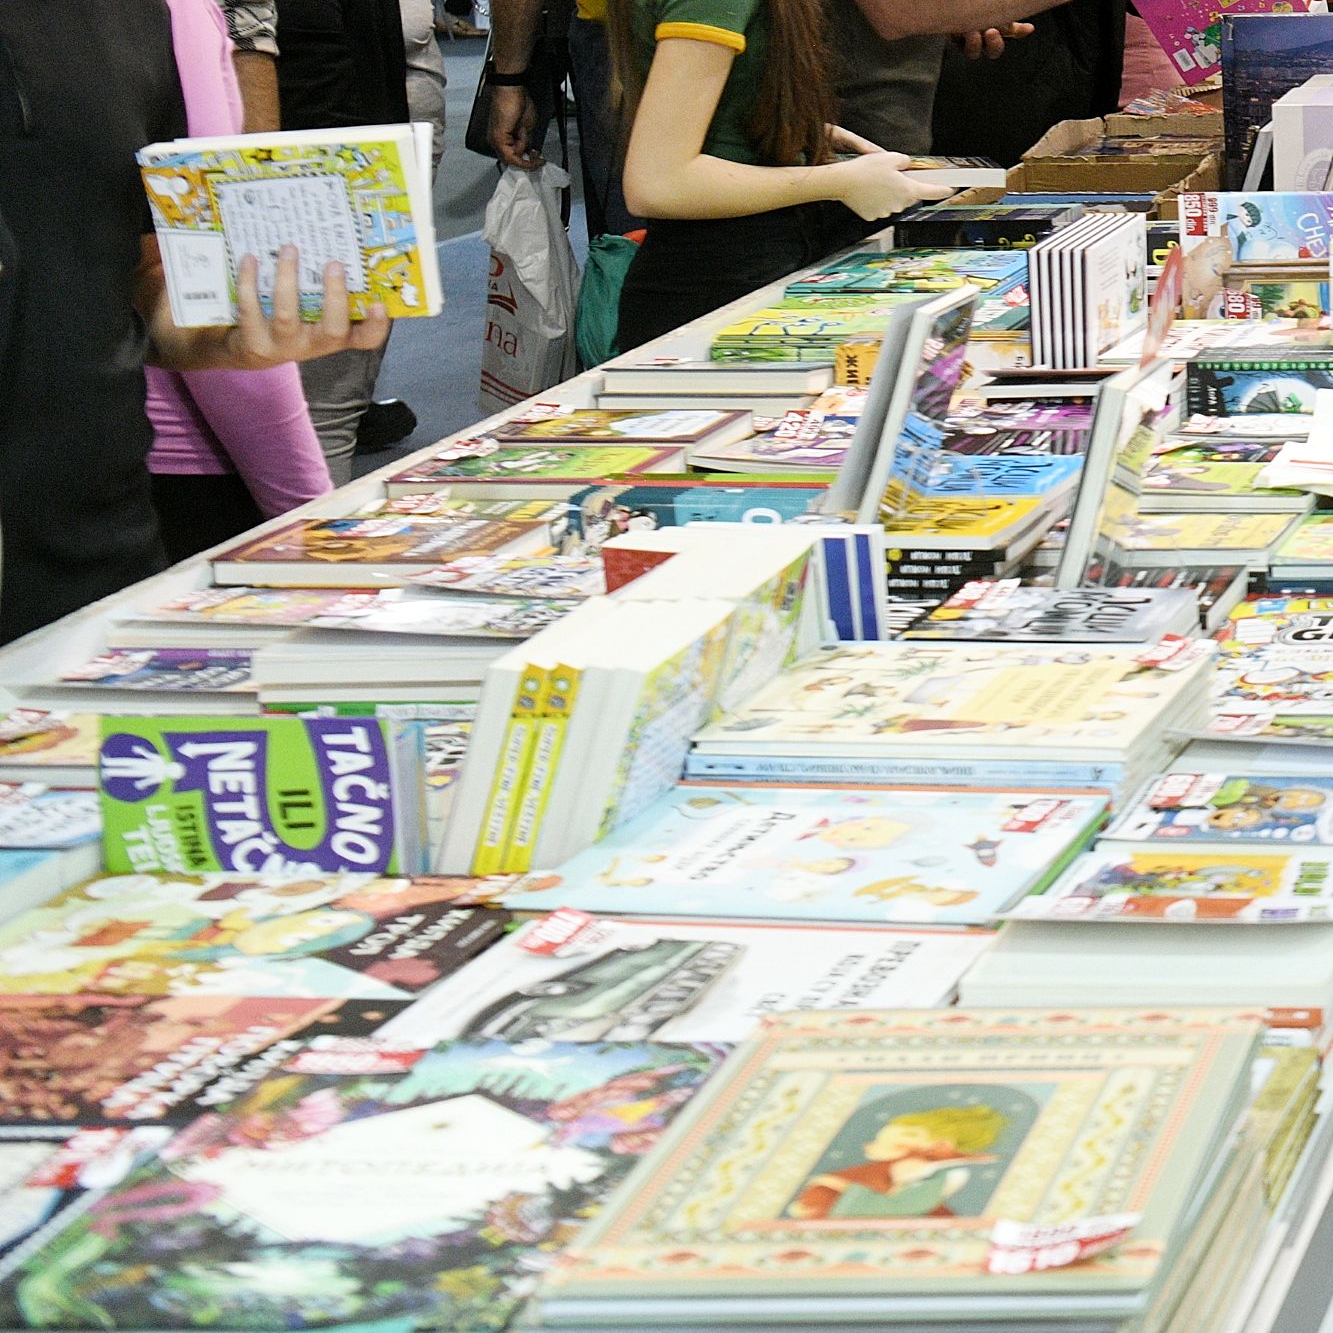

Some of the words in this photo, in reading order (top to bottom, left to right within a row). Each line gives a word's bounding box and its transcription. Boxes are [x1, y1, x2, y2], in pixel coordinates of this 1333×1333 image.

[1184, 193, 1203, 218] 850
[277, 788, 313, 831] ILI
[321, 726, 382, 865] TAČNO
